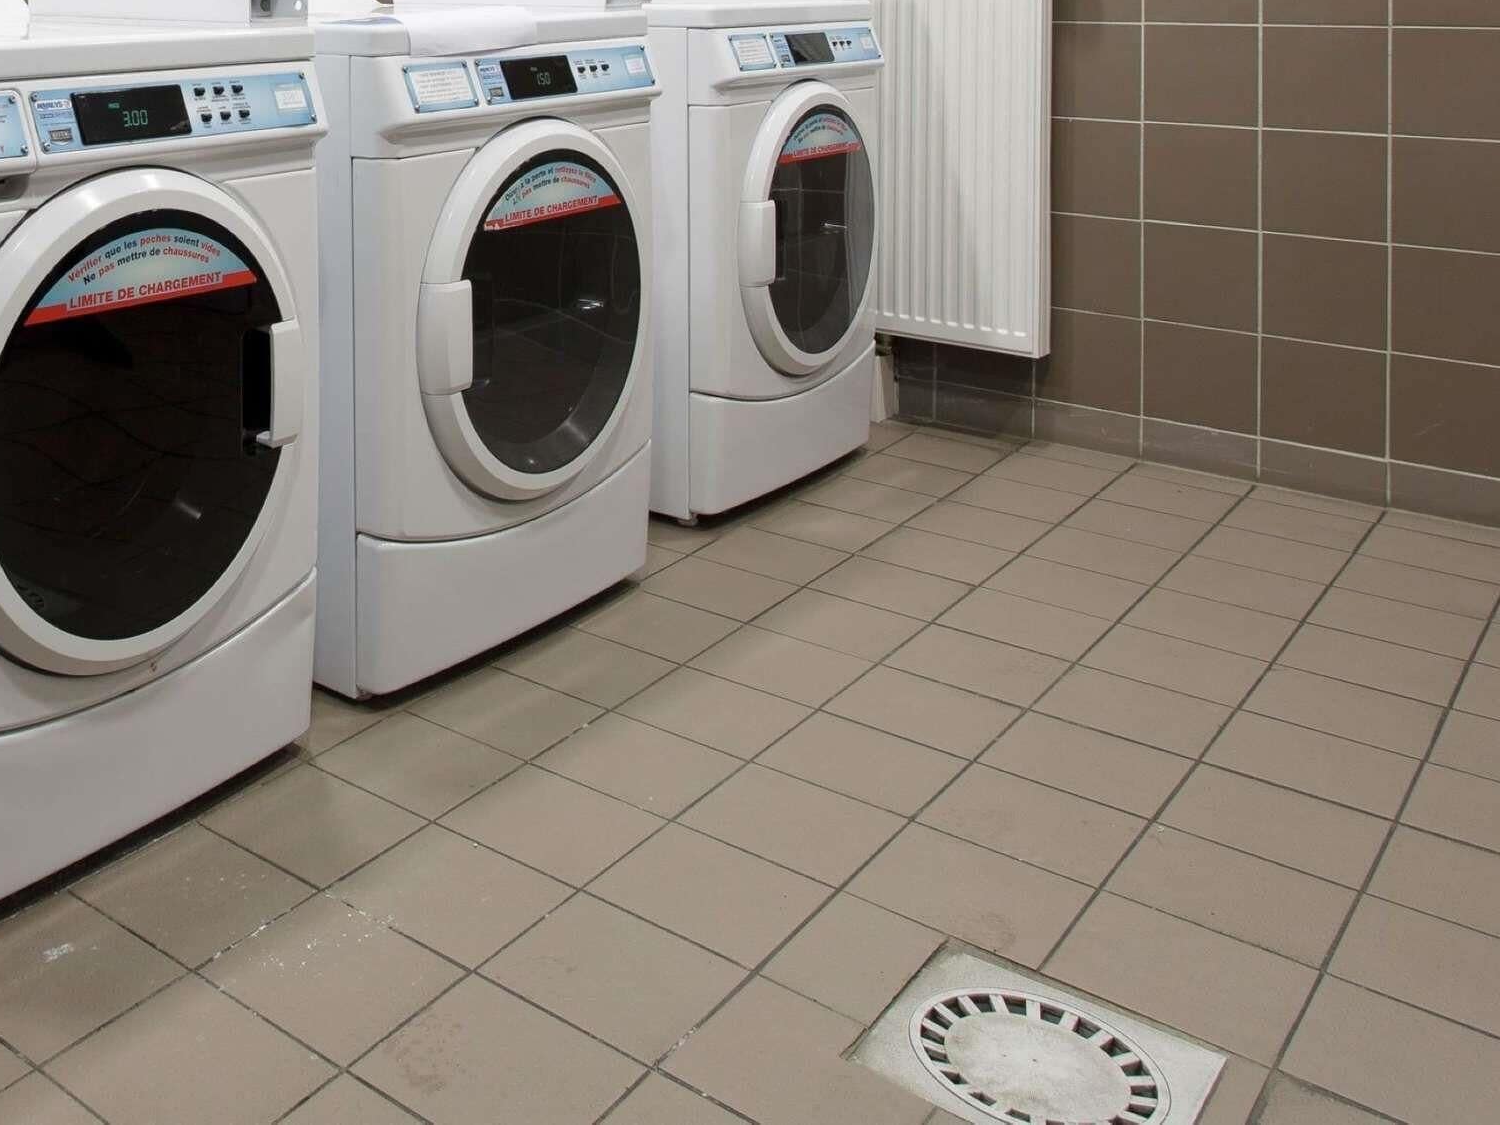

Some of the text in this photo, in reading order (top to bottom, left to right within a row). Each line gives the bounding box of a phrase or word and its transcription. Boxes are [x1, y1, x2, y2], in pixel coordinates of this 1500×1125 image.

[122, 109, 149, 127] 3.00
[504, 195, 598, 223] LIMITE DE CHARGEMENT
[105, 246, 121, 259] que
[124, 239, 137, 249] les
[140, 234, 171, 247] poches
[174, 235, 199, 247] soient
[201, 242, 220, 256] vides
[98, 262, 115, 278] pas
[117, 250, 147, 266] mettre
[149, 247, 161, 256] de
[163, 246, 209, 263] chaussures
[70, 271, 222, 309] LIMITE DE CHARGEMENT
